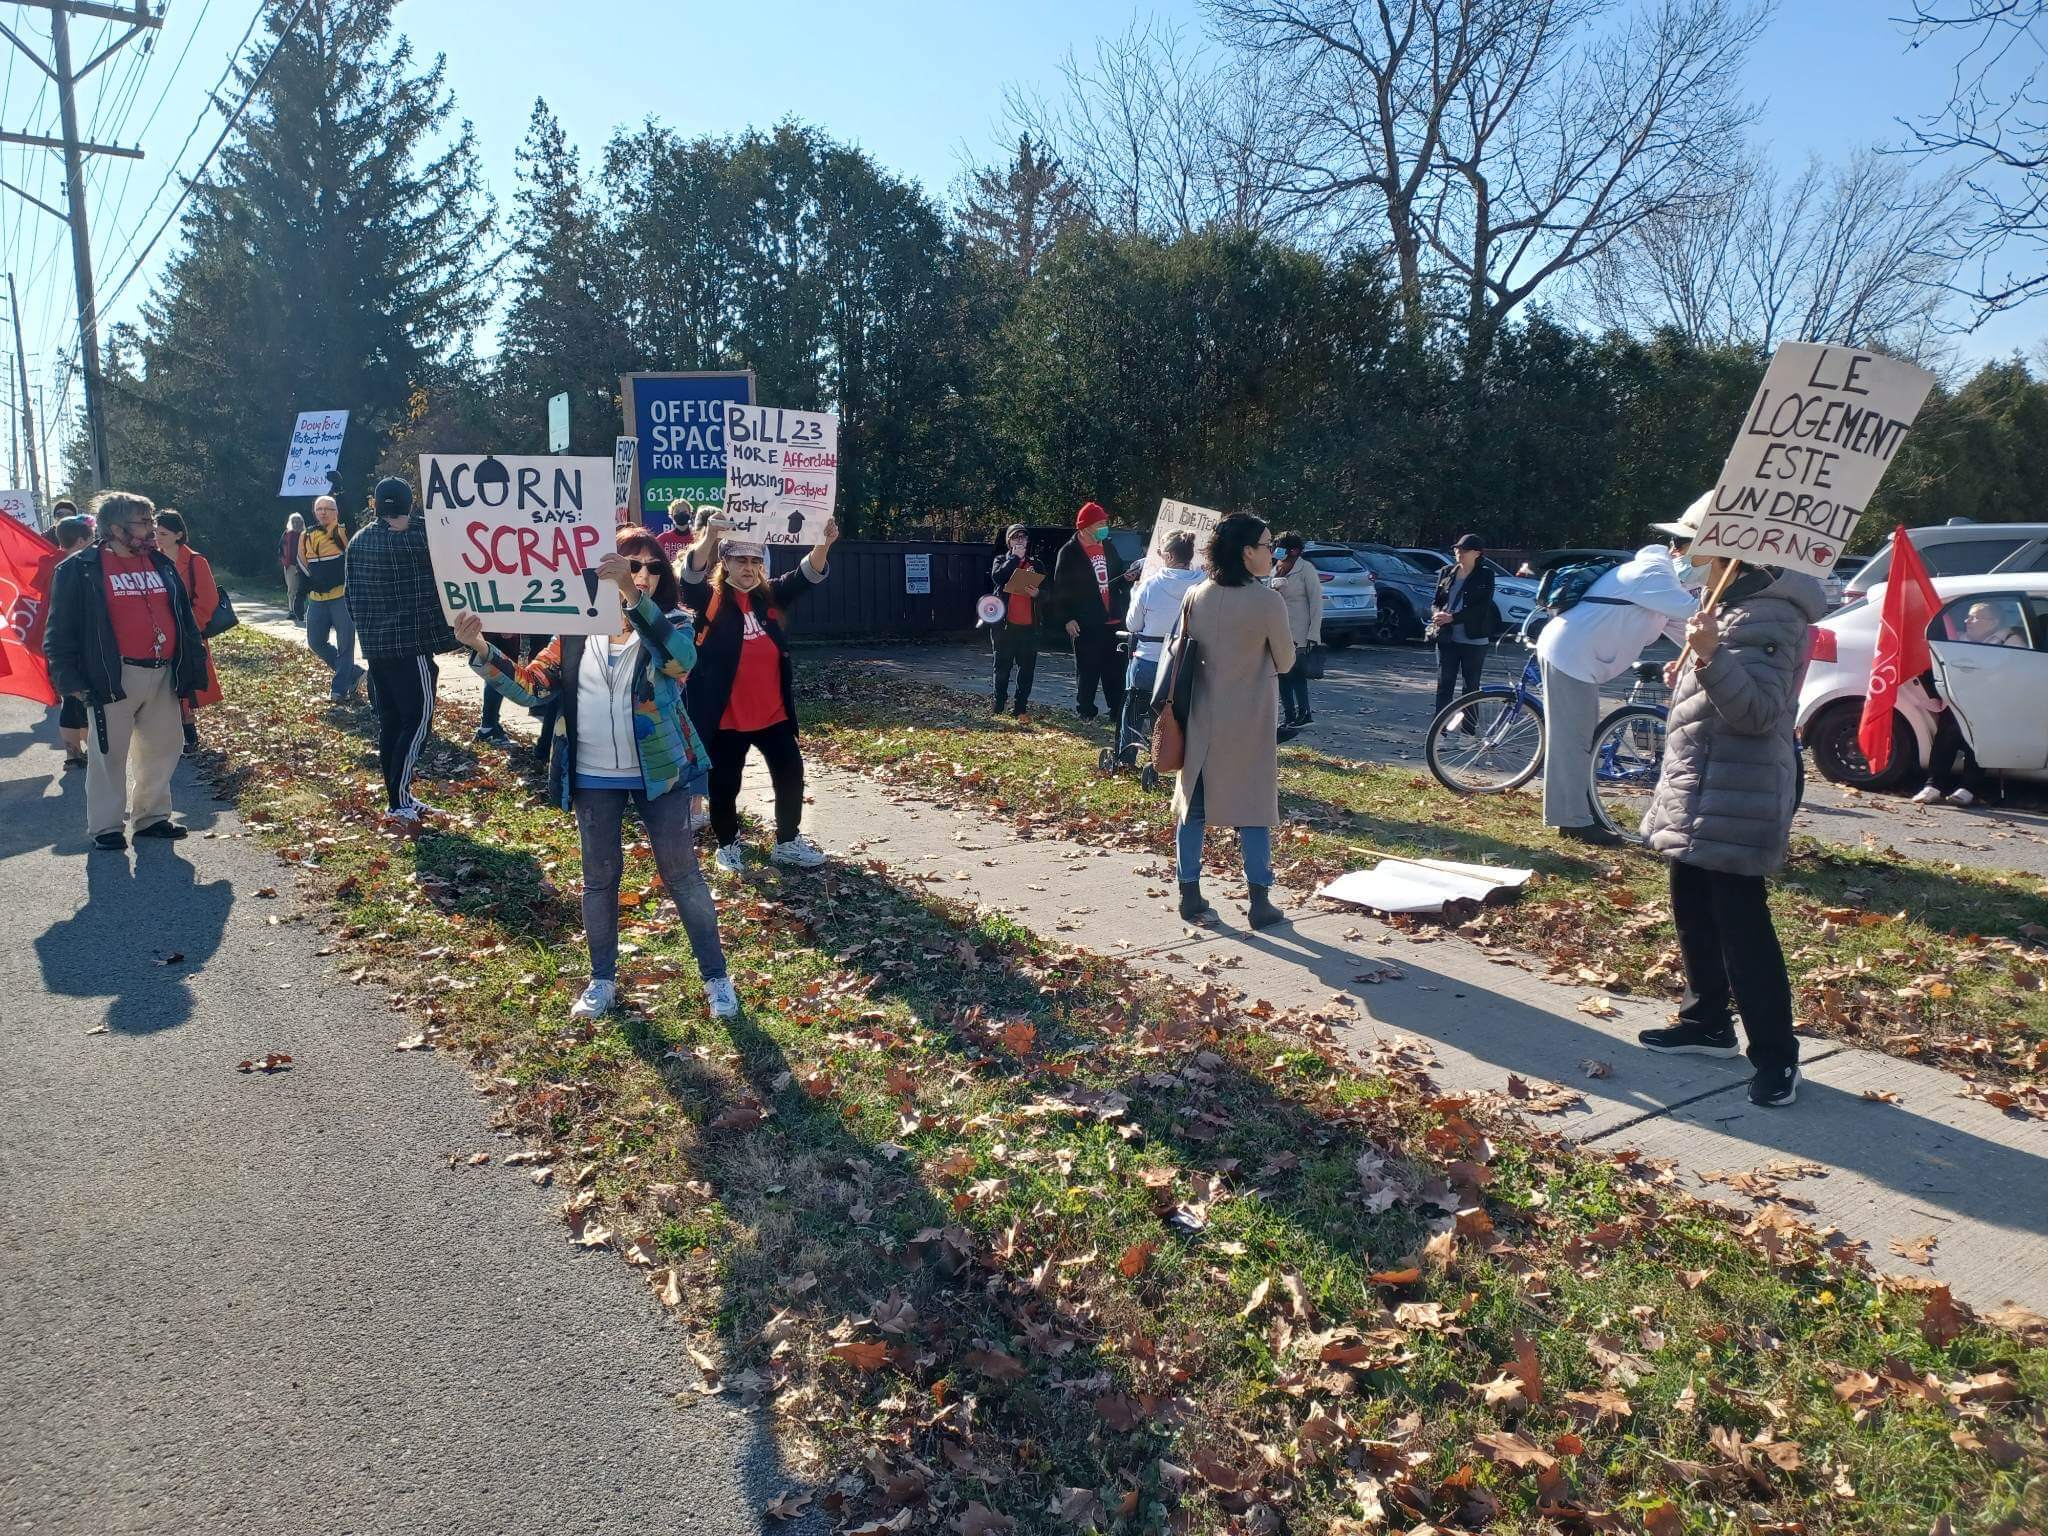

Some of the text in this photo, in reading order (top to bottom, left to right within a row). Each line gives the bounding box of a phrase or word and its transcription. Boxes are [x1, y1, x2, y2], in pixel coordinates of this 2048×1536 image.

[1808, 349, 1873, 396] LE
[652, 425, 728, 452] SPAC
[791, 419, 823, 441] 23
[1748, 388, 1911, 461] LOGEMENT
[652, 454, 727, 470] FOR LEAS
[1755, 442, 1840, 489] ESTE
[426, 455, 583, 511] ACORN
[646, 487, 727, 502] 613.726.80
[730, 466, 785, 497] Housing
[531, 510, 582, 524] SAYS:
[726, 492, 769, 514] Faster
[1159, 501, 1175, 523] A
[1715, 484, 1862, 540] UN DROIT
[764, 530, 801, 544] ACORN
[1698, 521, 1811, 561] ACORN
[443, 579, 515, 613] BILL
[521, 578, 567, 604] 23
